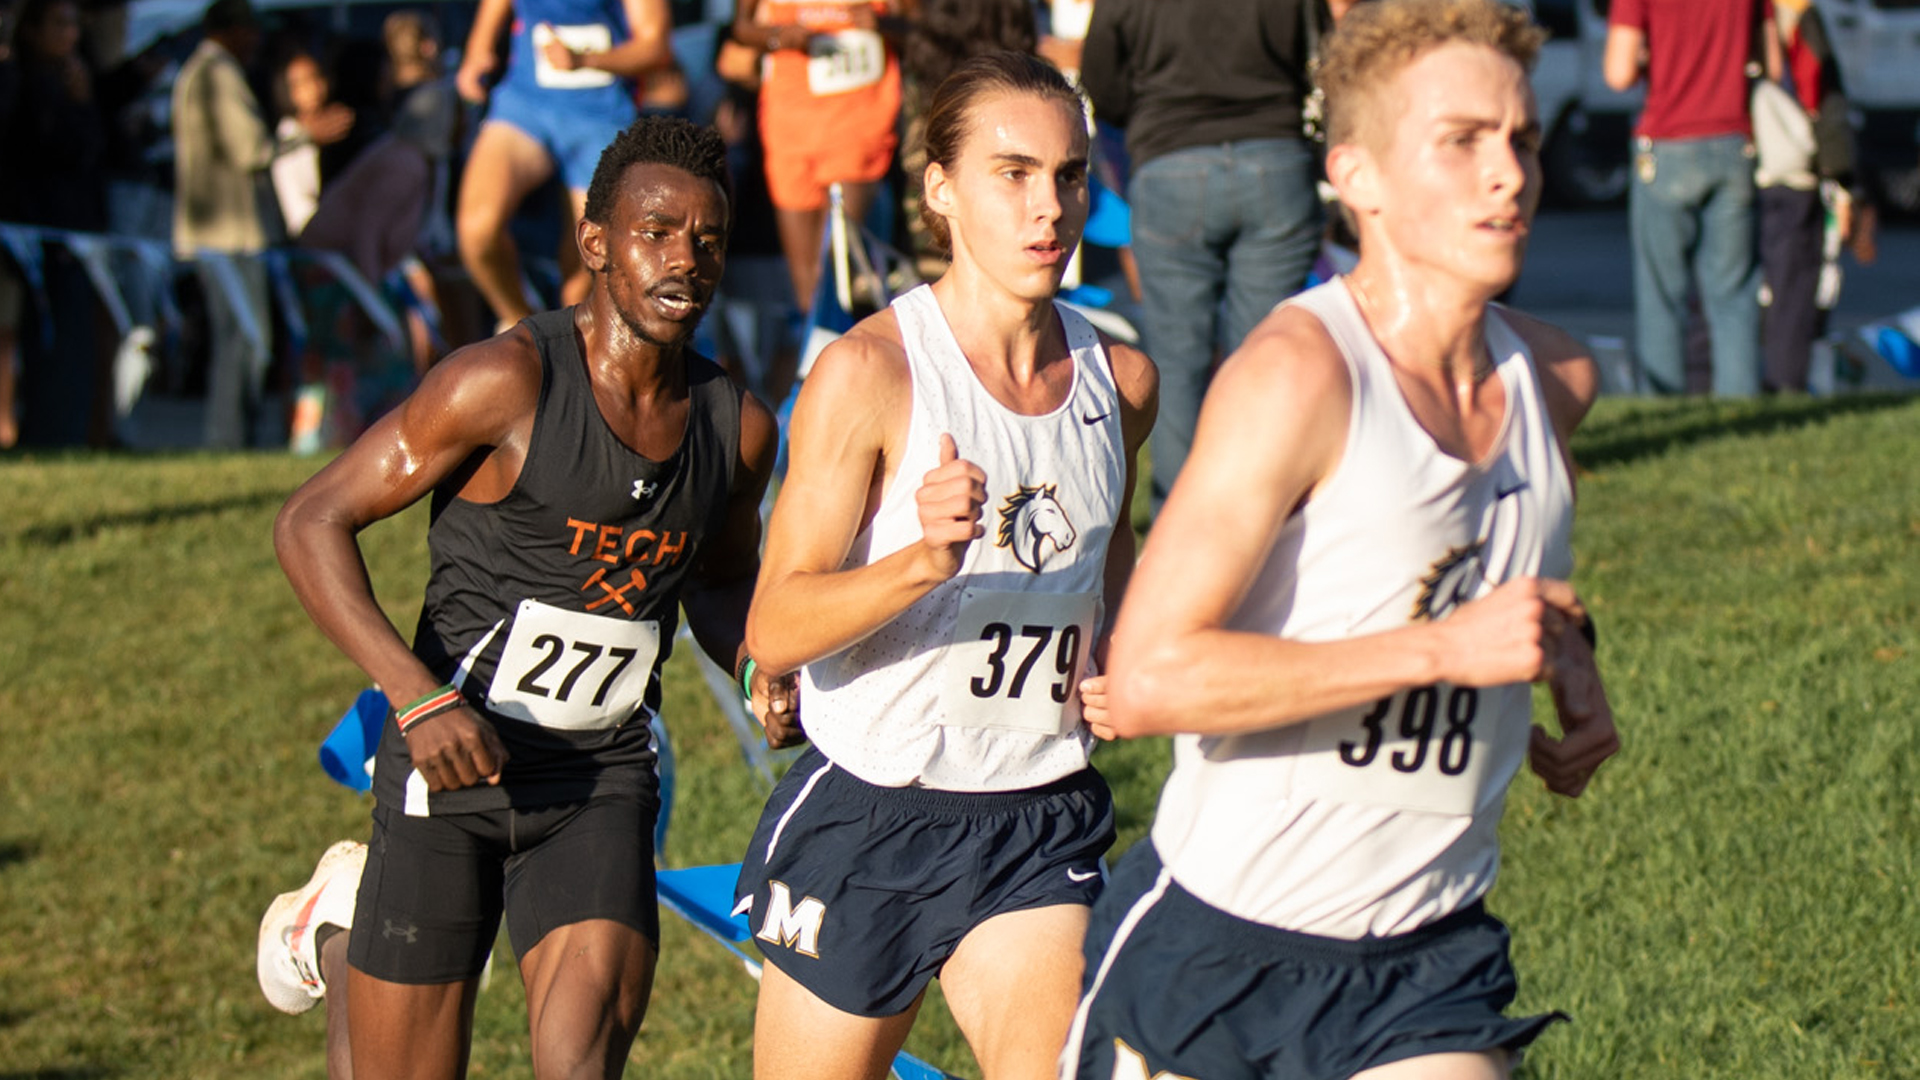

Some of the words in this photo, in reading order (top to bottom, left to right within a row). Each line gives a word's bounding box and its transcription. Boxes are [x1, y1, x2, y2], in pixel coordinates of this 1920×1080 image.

[566, 517, 688, 566] TECH
[516, 634, 638, 706] 277
[970, 622, 1081, 704] 379
[1339, 686, 1478, 776] 398
[756, 879, 827, 960] M
